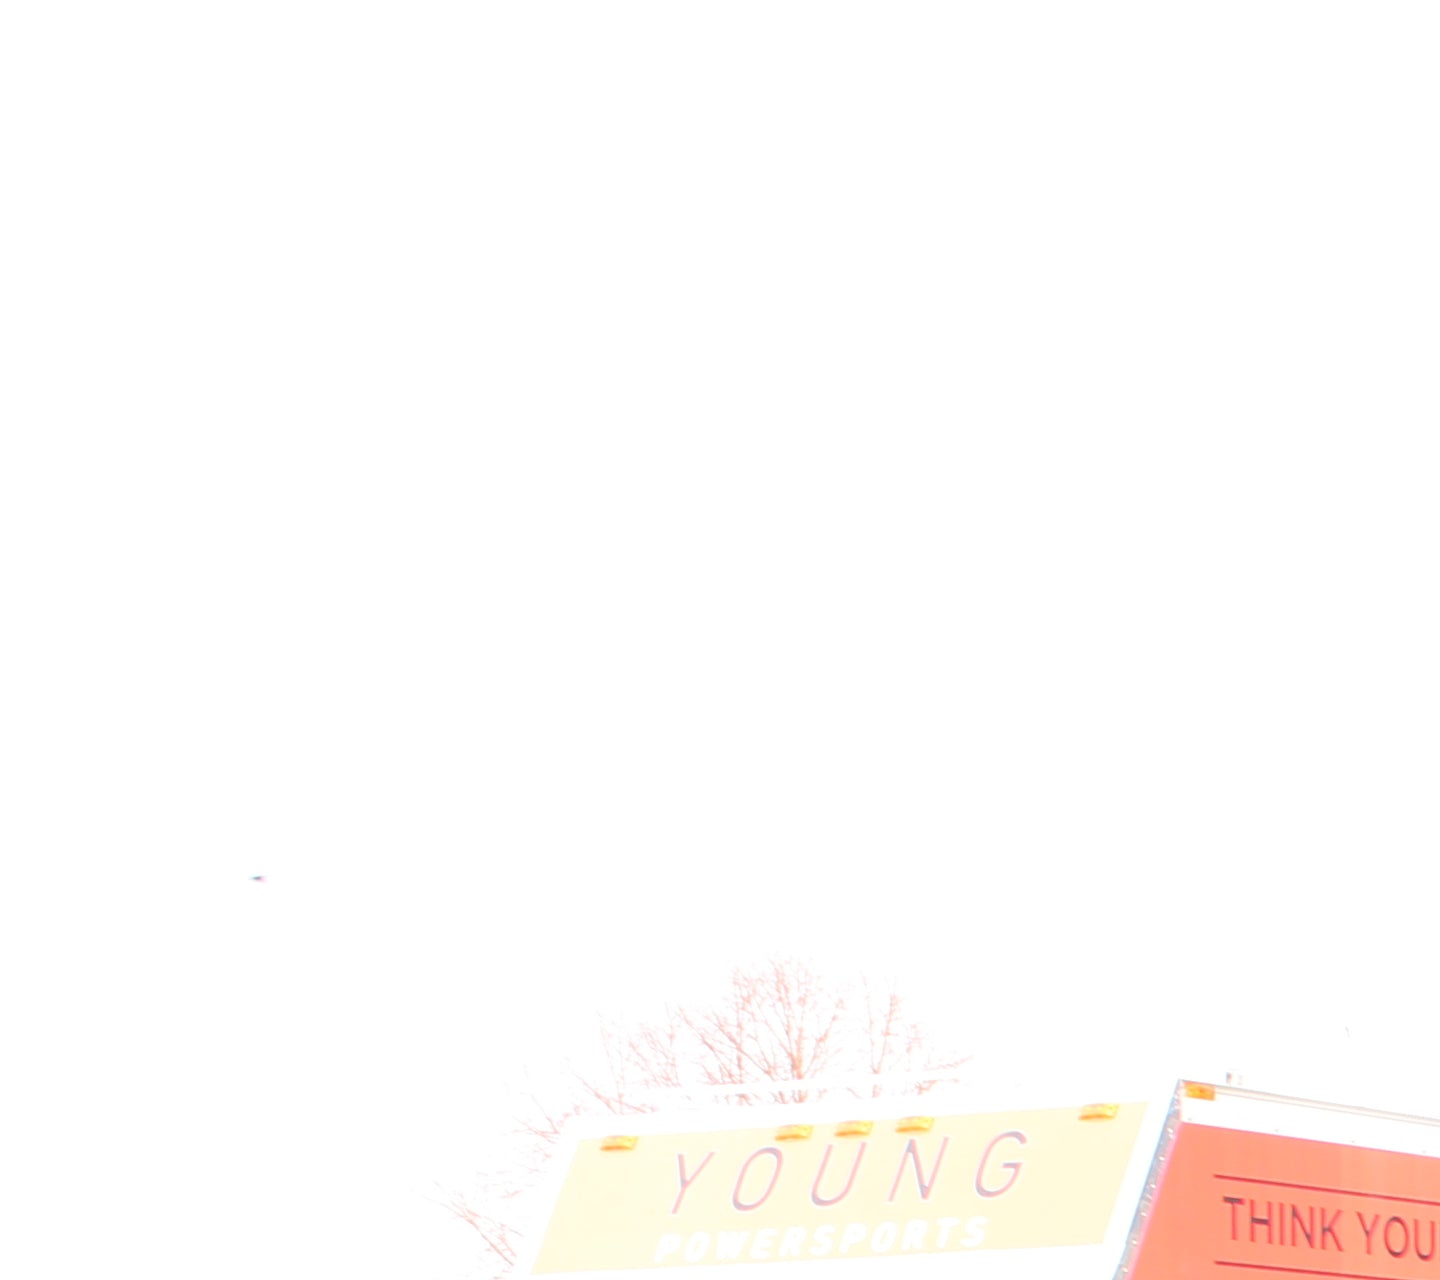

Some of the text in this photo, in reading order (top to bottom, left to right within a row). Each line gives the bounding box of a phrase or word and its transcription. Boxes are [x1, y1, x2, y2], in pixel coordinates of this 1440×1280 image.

[670, 1129, 1028, 1215] YOUNG
[655, 1217, 986, 1262] POWERSPORTS
[1223, 1196, 1344, 1252] THINK
